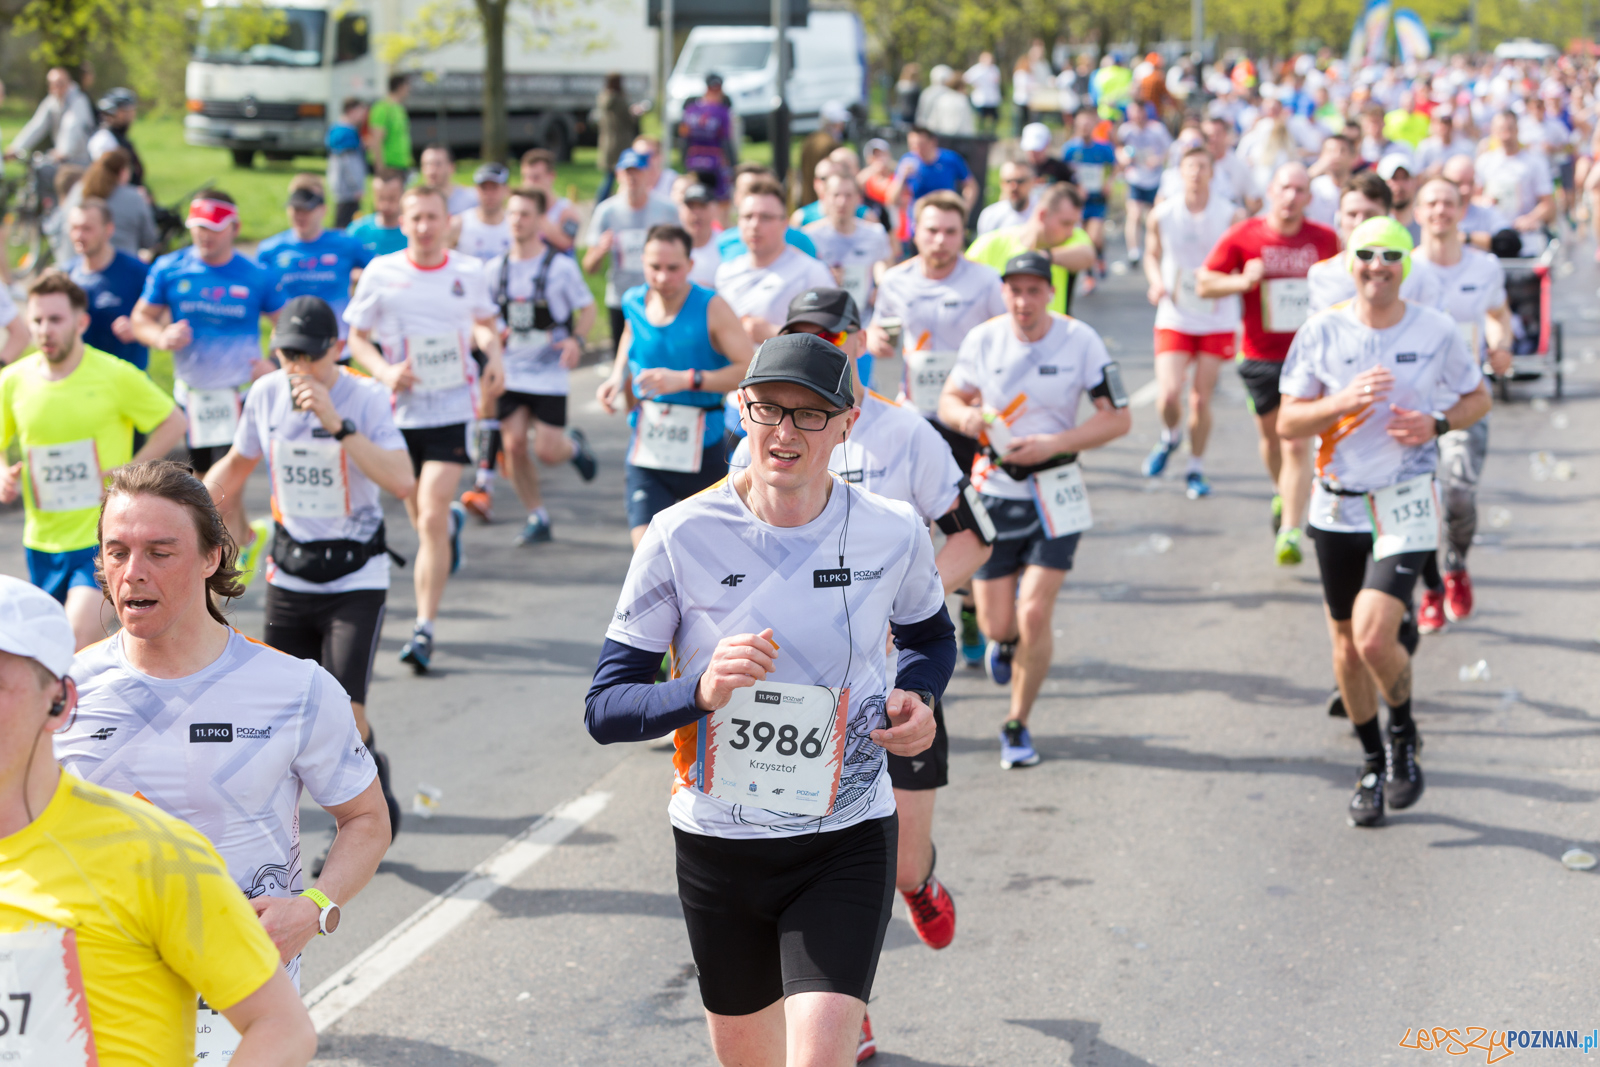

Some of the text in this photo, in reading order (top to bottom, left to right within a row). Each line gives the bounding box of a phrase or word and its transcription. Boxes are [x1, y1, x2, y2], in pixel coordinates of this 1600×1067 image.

[42, 462, 88, 482] 2252
[283, 465, 333, 487] 3585
[728, 718, 822, 759] 3986
[749, 759, 797, 773] Krzysztof
